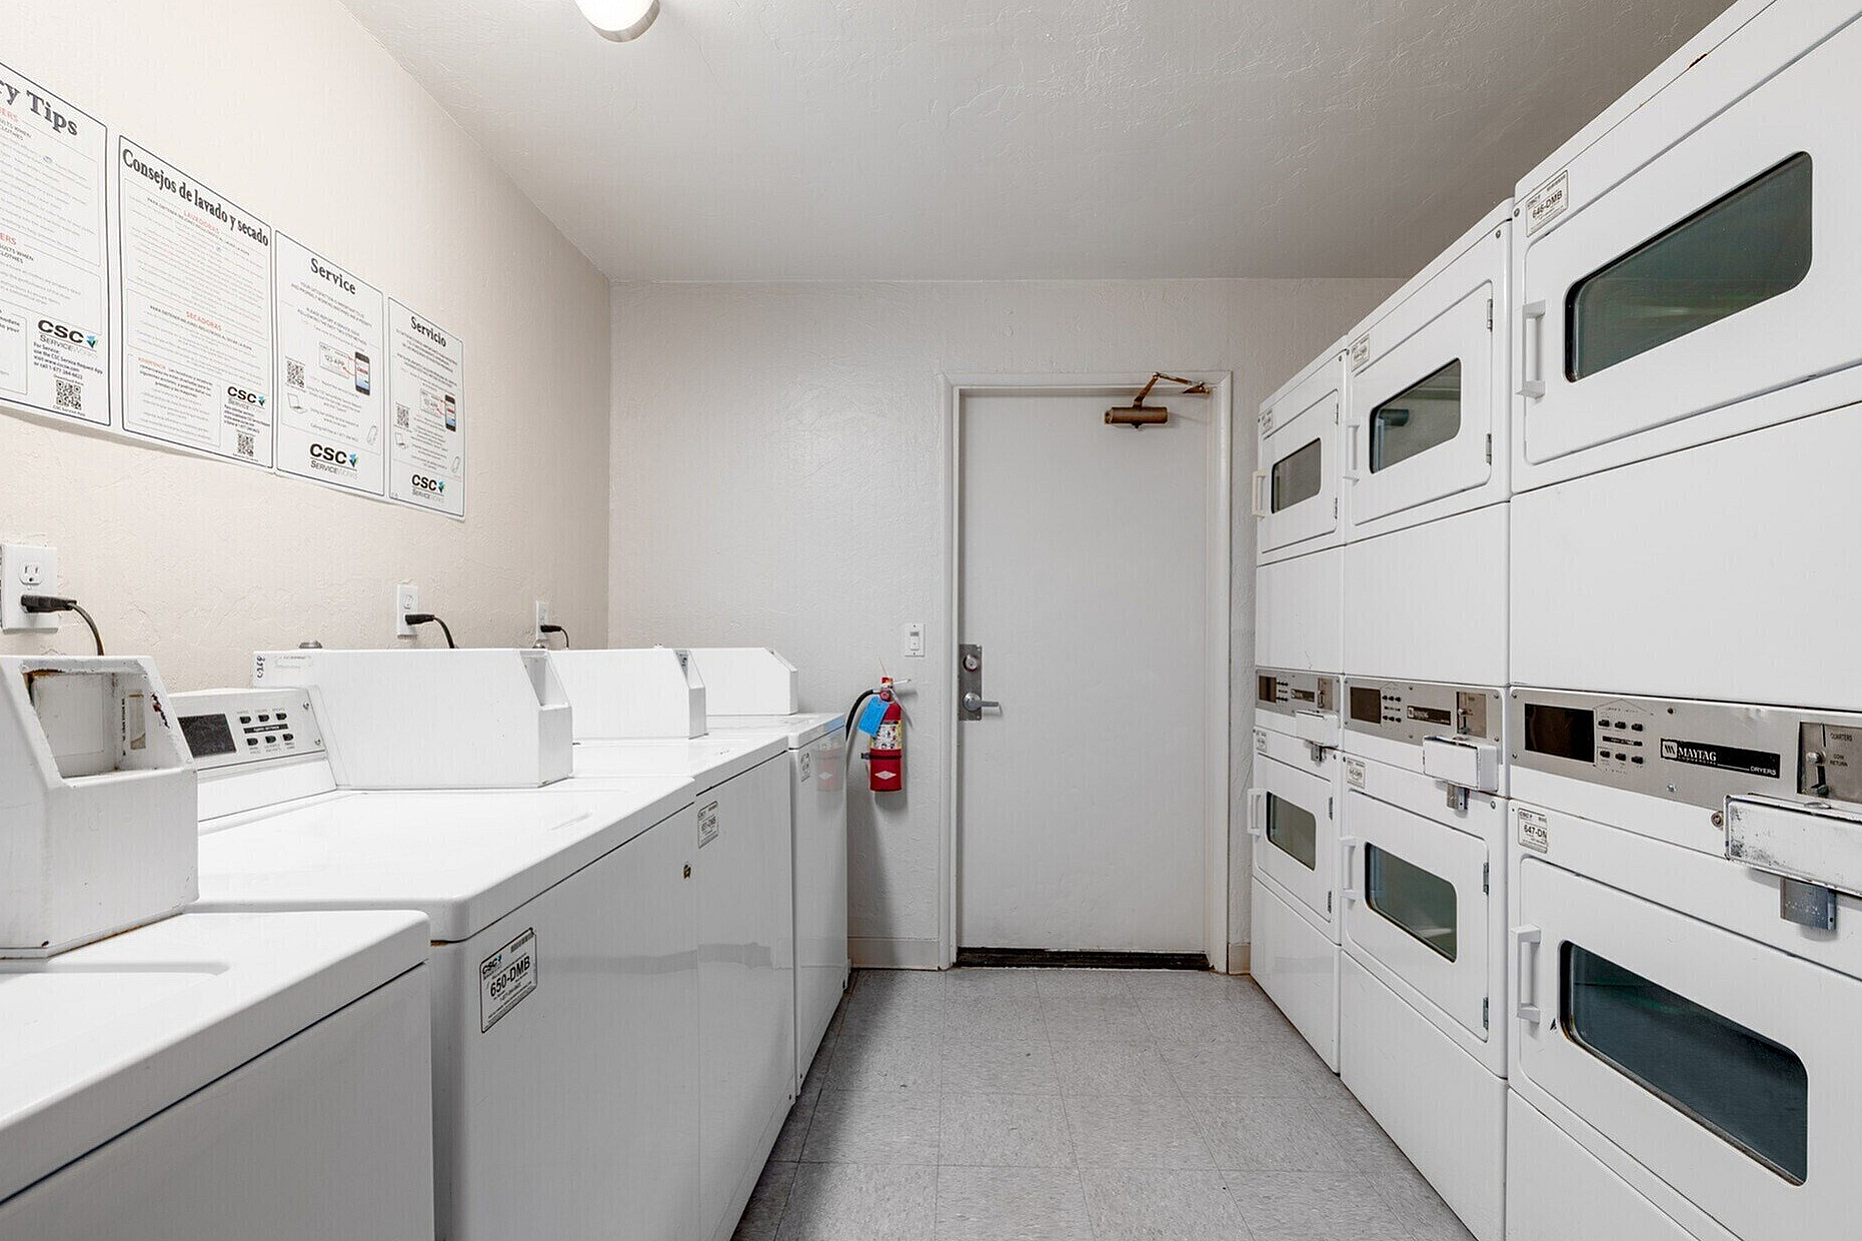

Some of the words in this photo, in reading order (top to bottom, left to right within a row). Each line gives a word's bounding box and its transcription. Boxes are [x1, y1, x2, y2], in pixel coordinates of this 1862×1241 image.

[26, 90, 78, 136] Tips
[123, 148, 177, 192] Consejos
[179, 182, 193, 202] de
[194, 189, 228, 223] lavado
[229, 215, 237, 231] y
[237, 219, 269, 247] secado
[310, 257, 356, 295] Service
[38, 319, 84, 344] CSC
[410, 315, 447, 348] Servicio
[227, 386, 257, 404] CSC
[310, 443, 347, 465] CSC
[411, 474, 437, 491] CSC
[1678, 747, 1717, 762] MAYTAG
[1750, 765, 1777, 776] DRYERS
[490, 955, 531, 997] 650-DMB
